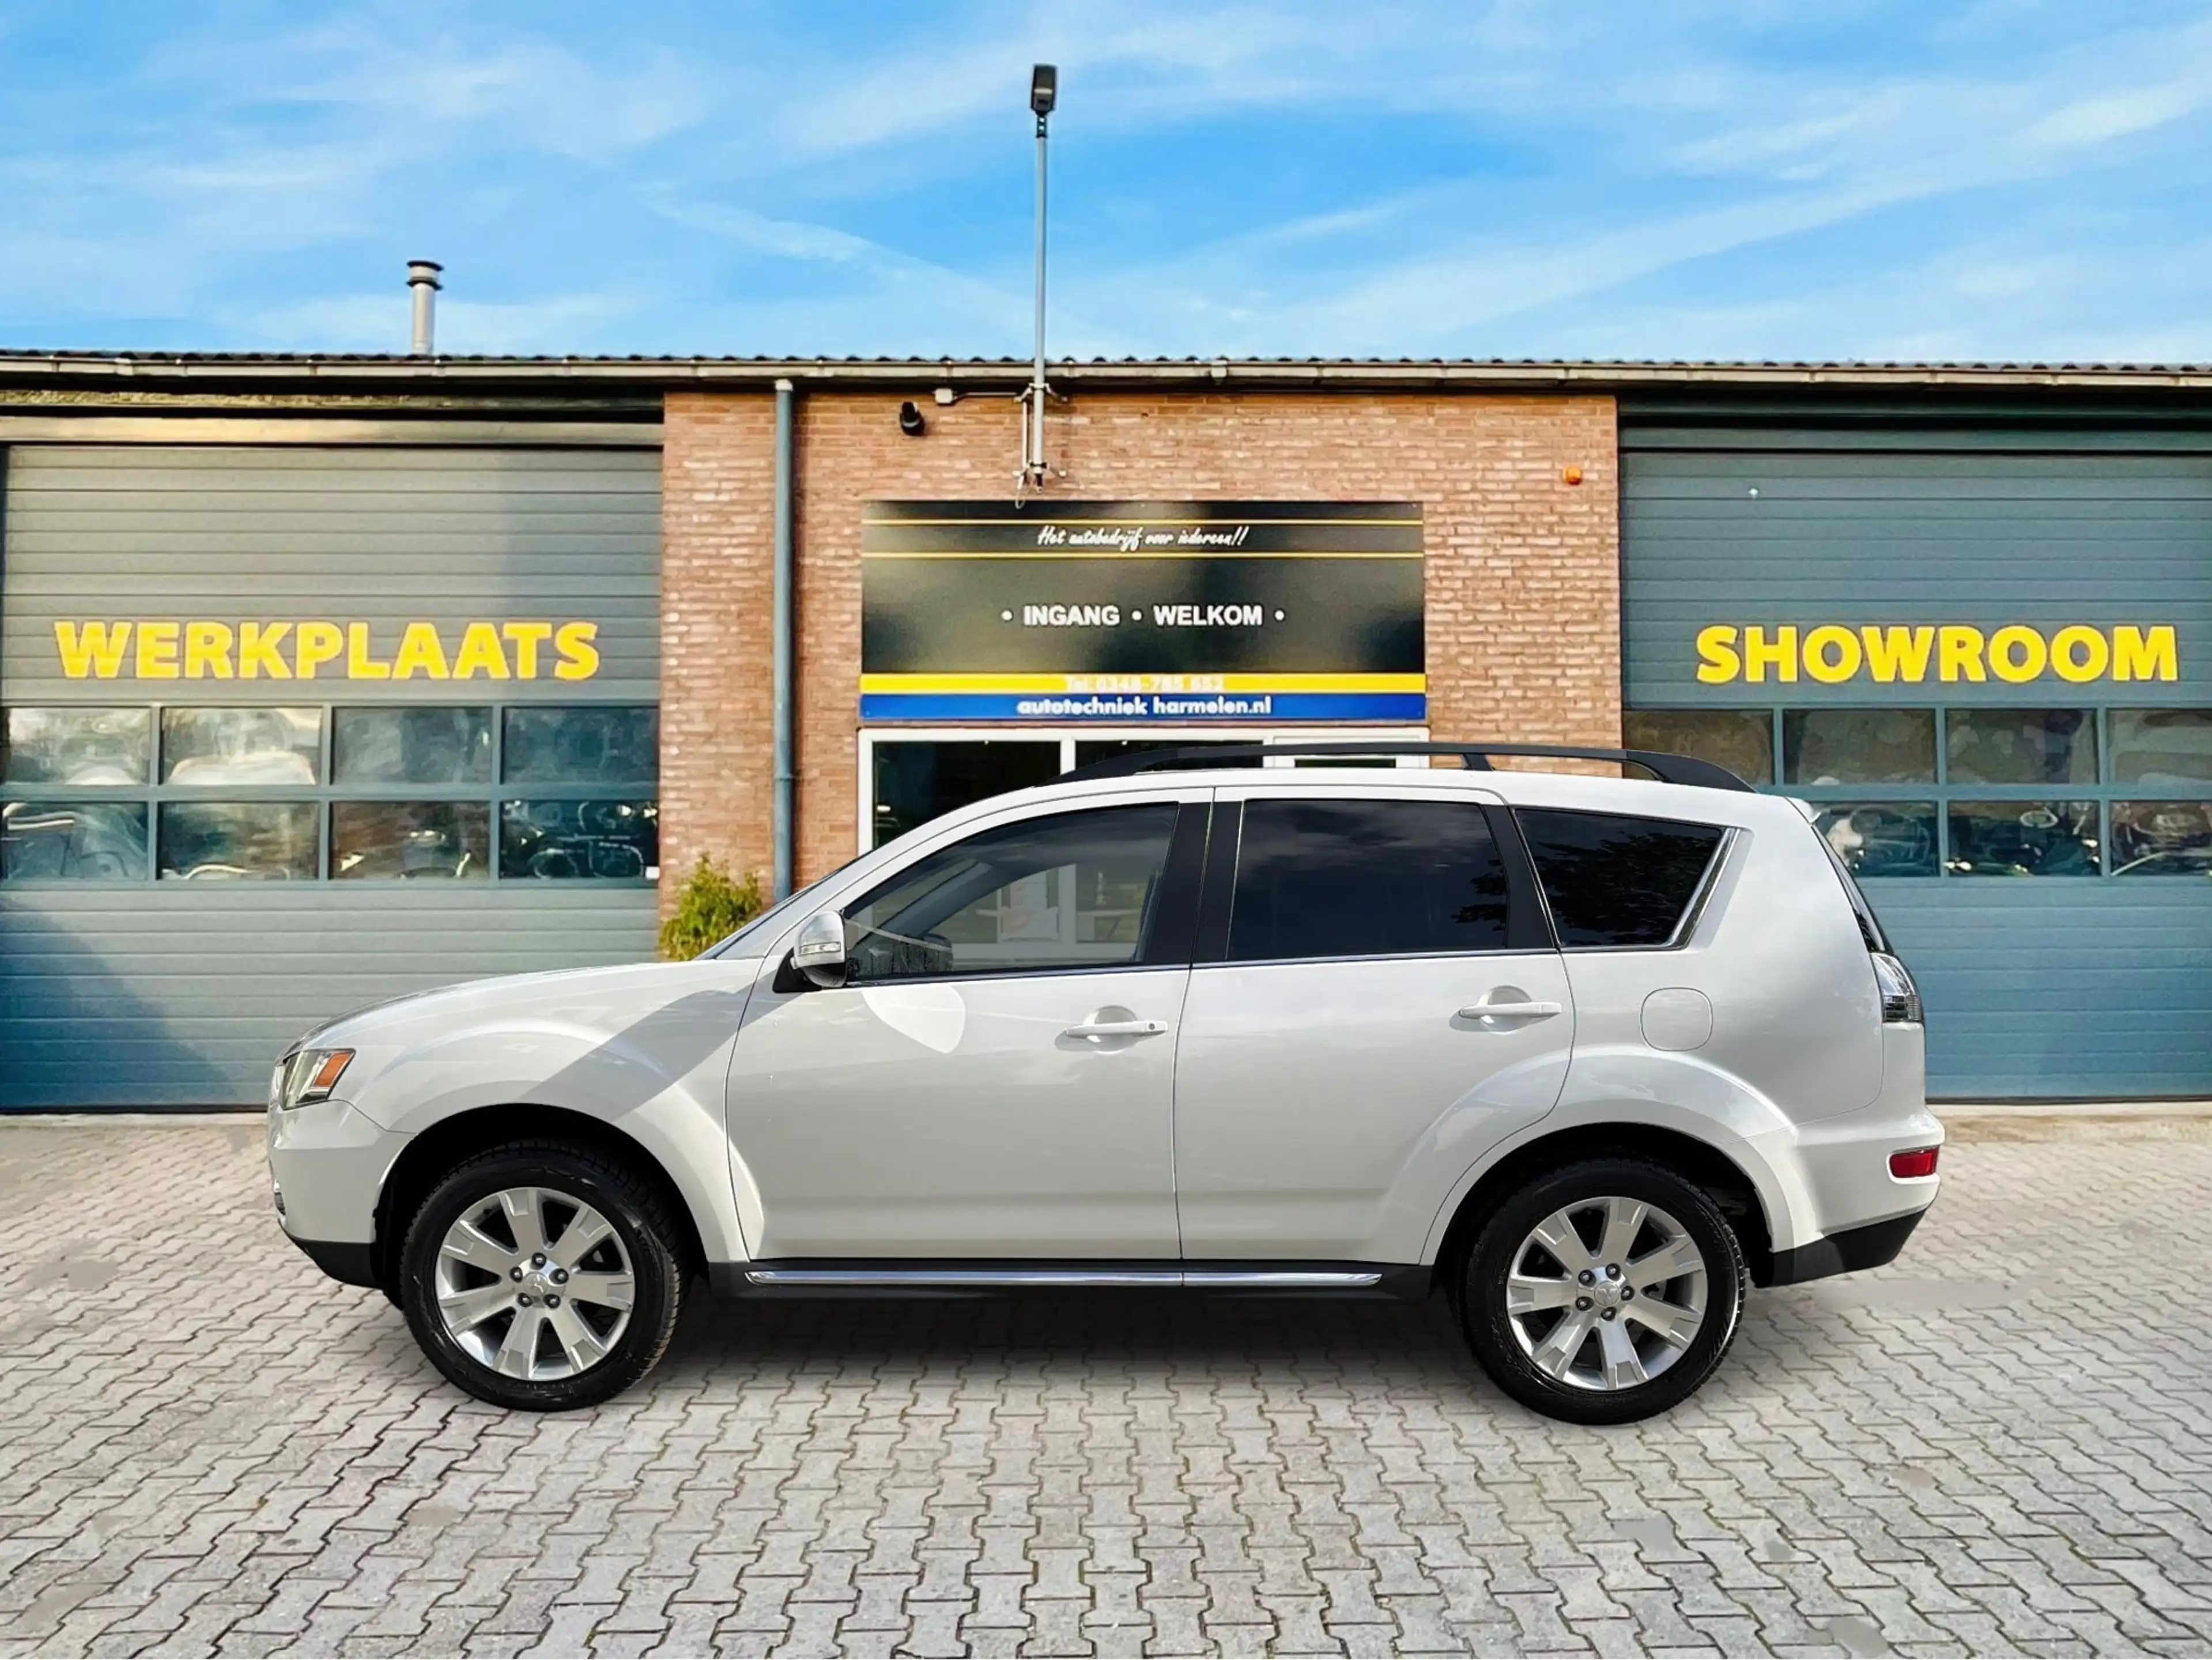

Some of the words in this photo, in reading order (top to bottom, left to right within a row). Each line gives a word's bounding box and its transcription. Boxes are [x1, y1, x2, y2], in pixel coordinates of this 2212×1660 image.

[1038, 525, 1066, 545] Het
[1069, 526, 1144, 552] autobedrijf
[1023, 605, 1120, 627] INGANG
[1153, 605, 1263, 626] WELKOM
[53, 620, 600, 681] WERKPLAATS
[1695, 624, 2179, 684] SHOWROOM
[1017, 696, 1147, 715] autotechniek
[1153, 695, 1271, 715] harmelen.nl
